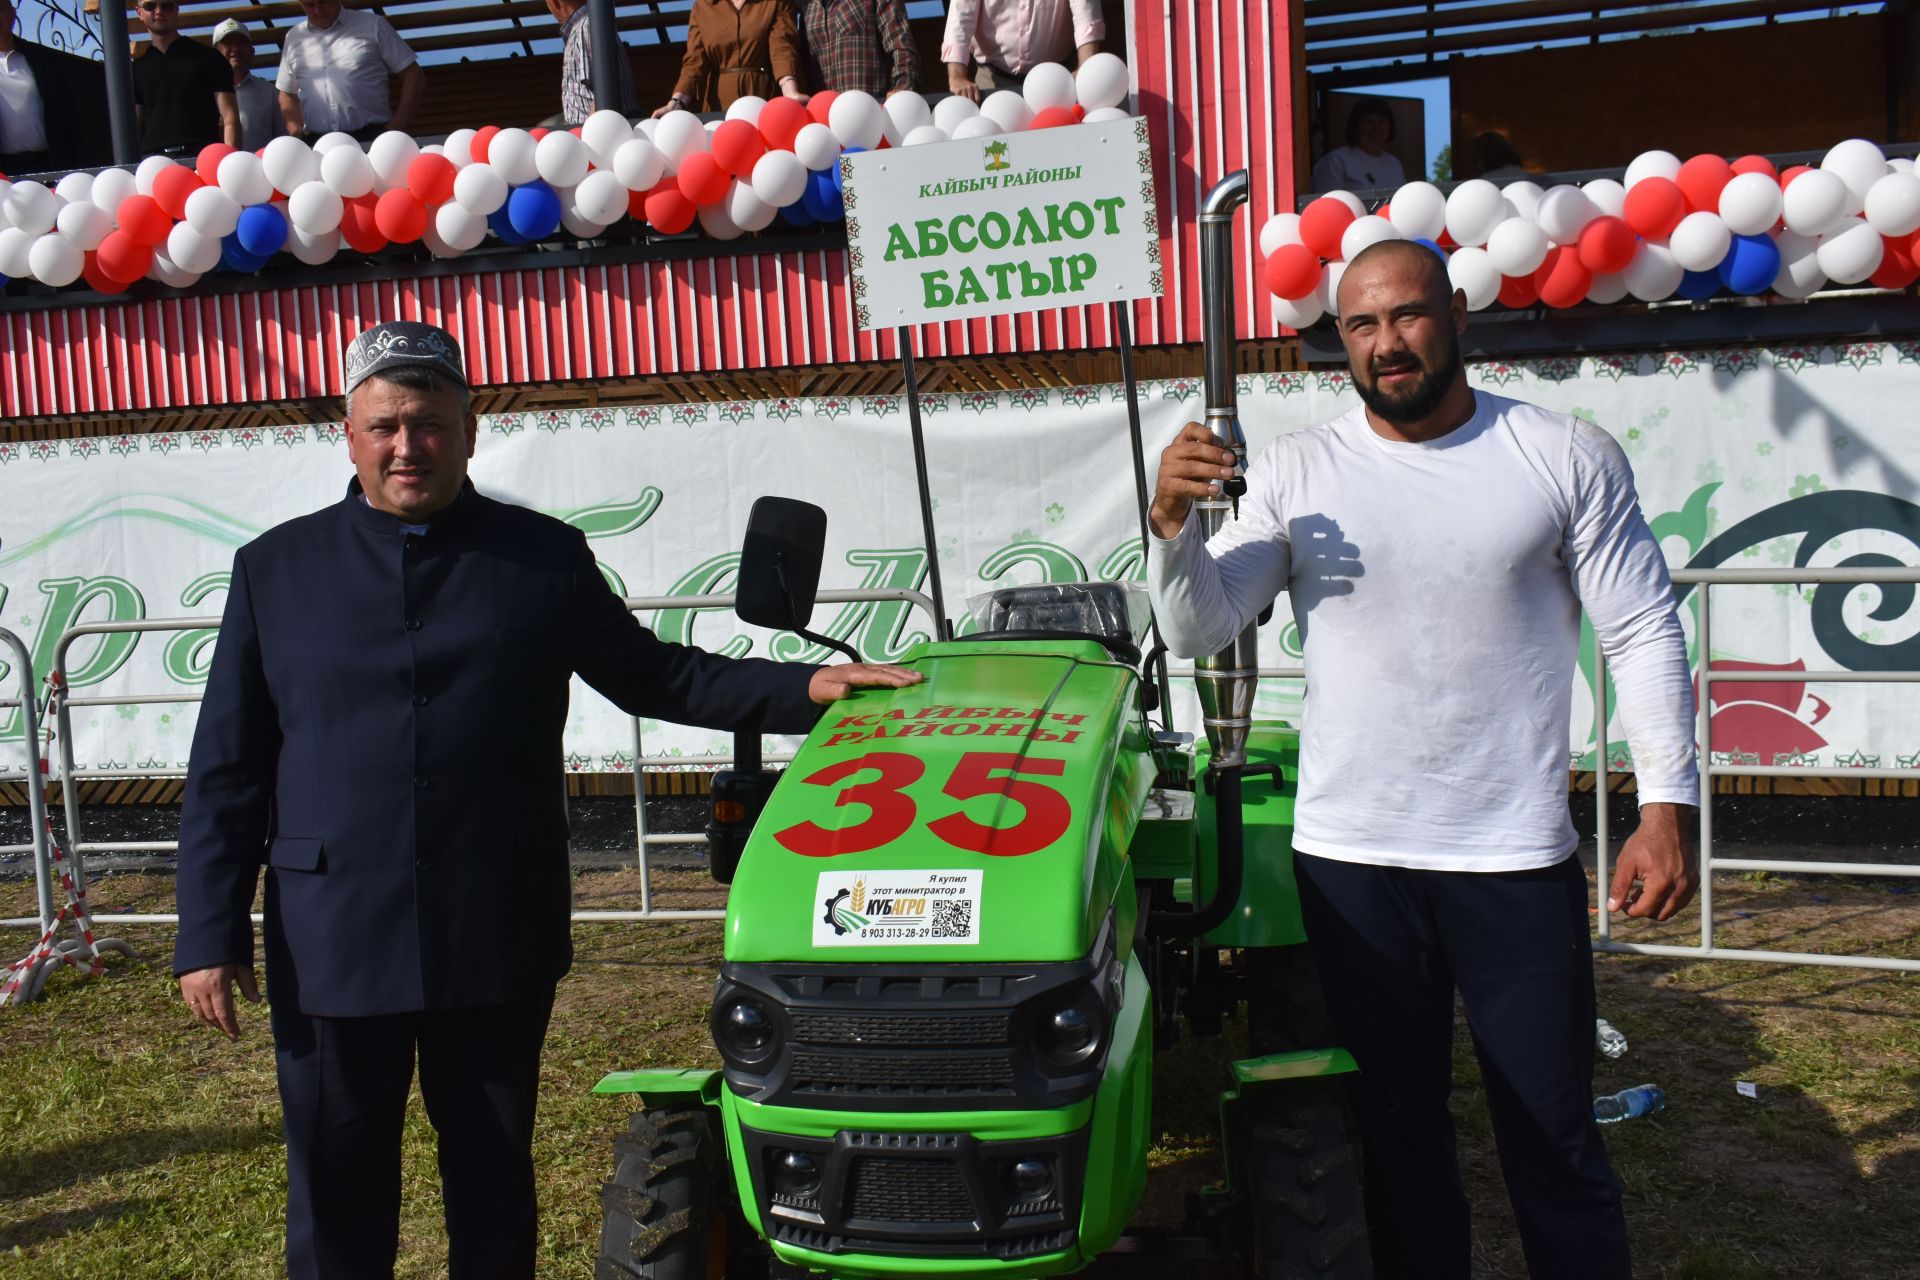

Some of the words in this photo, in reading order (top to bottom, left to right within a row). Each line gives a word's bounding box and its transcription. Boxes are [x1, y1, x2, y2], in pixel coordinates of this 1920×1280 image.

[919, 174, 998, 198] КАЙБЫЧ
[1003, 165, 1083, 188] РАЙОНЫ
[883, 196, 1126, 262] АБСОЛЮТ
[920, 252, 1098, 309] БАТЫР
[828, 705, 1089, 729] КАЙБЫЧ
[818, 721, 1086, 748] РАЙОНЫ
[772, 751, 1072, 858] 35
[871, 887, 893, 896] этот
[894, 886, 957, 897] минитрактор
[958, 887, 966, 895] в
[928, 874, 938, 884] Я
[938, 875, 967, 885] купил
[865, 898, 927, 916] КУБАГРО
[861, 928, 867, 938] 8
[868, 928, 885, 938] 903
[886, 927, 930, 938] 313-28-29
